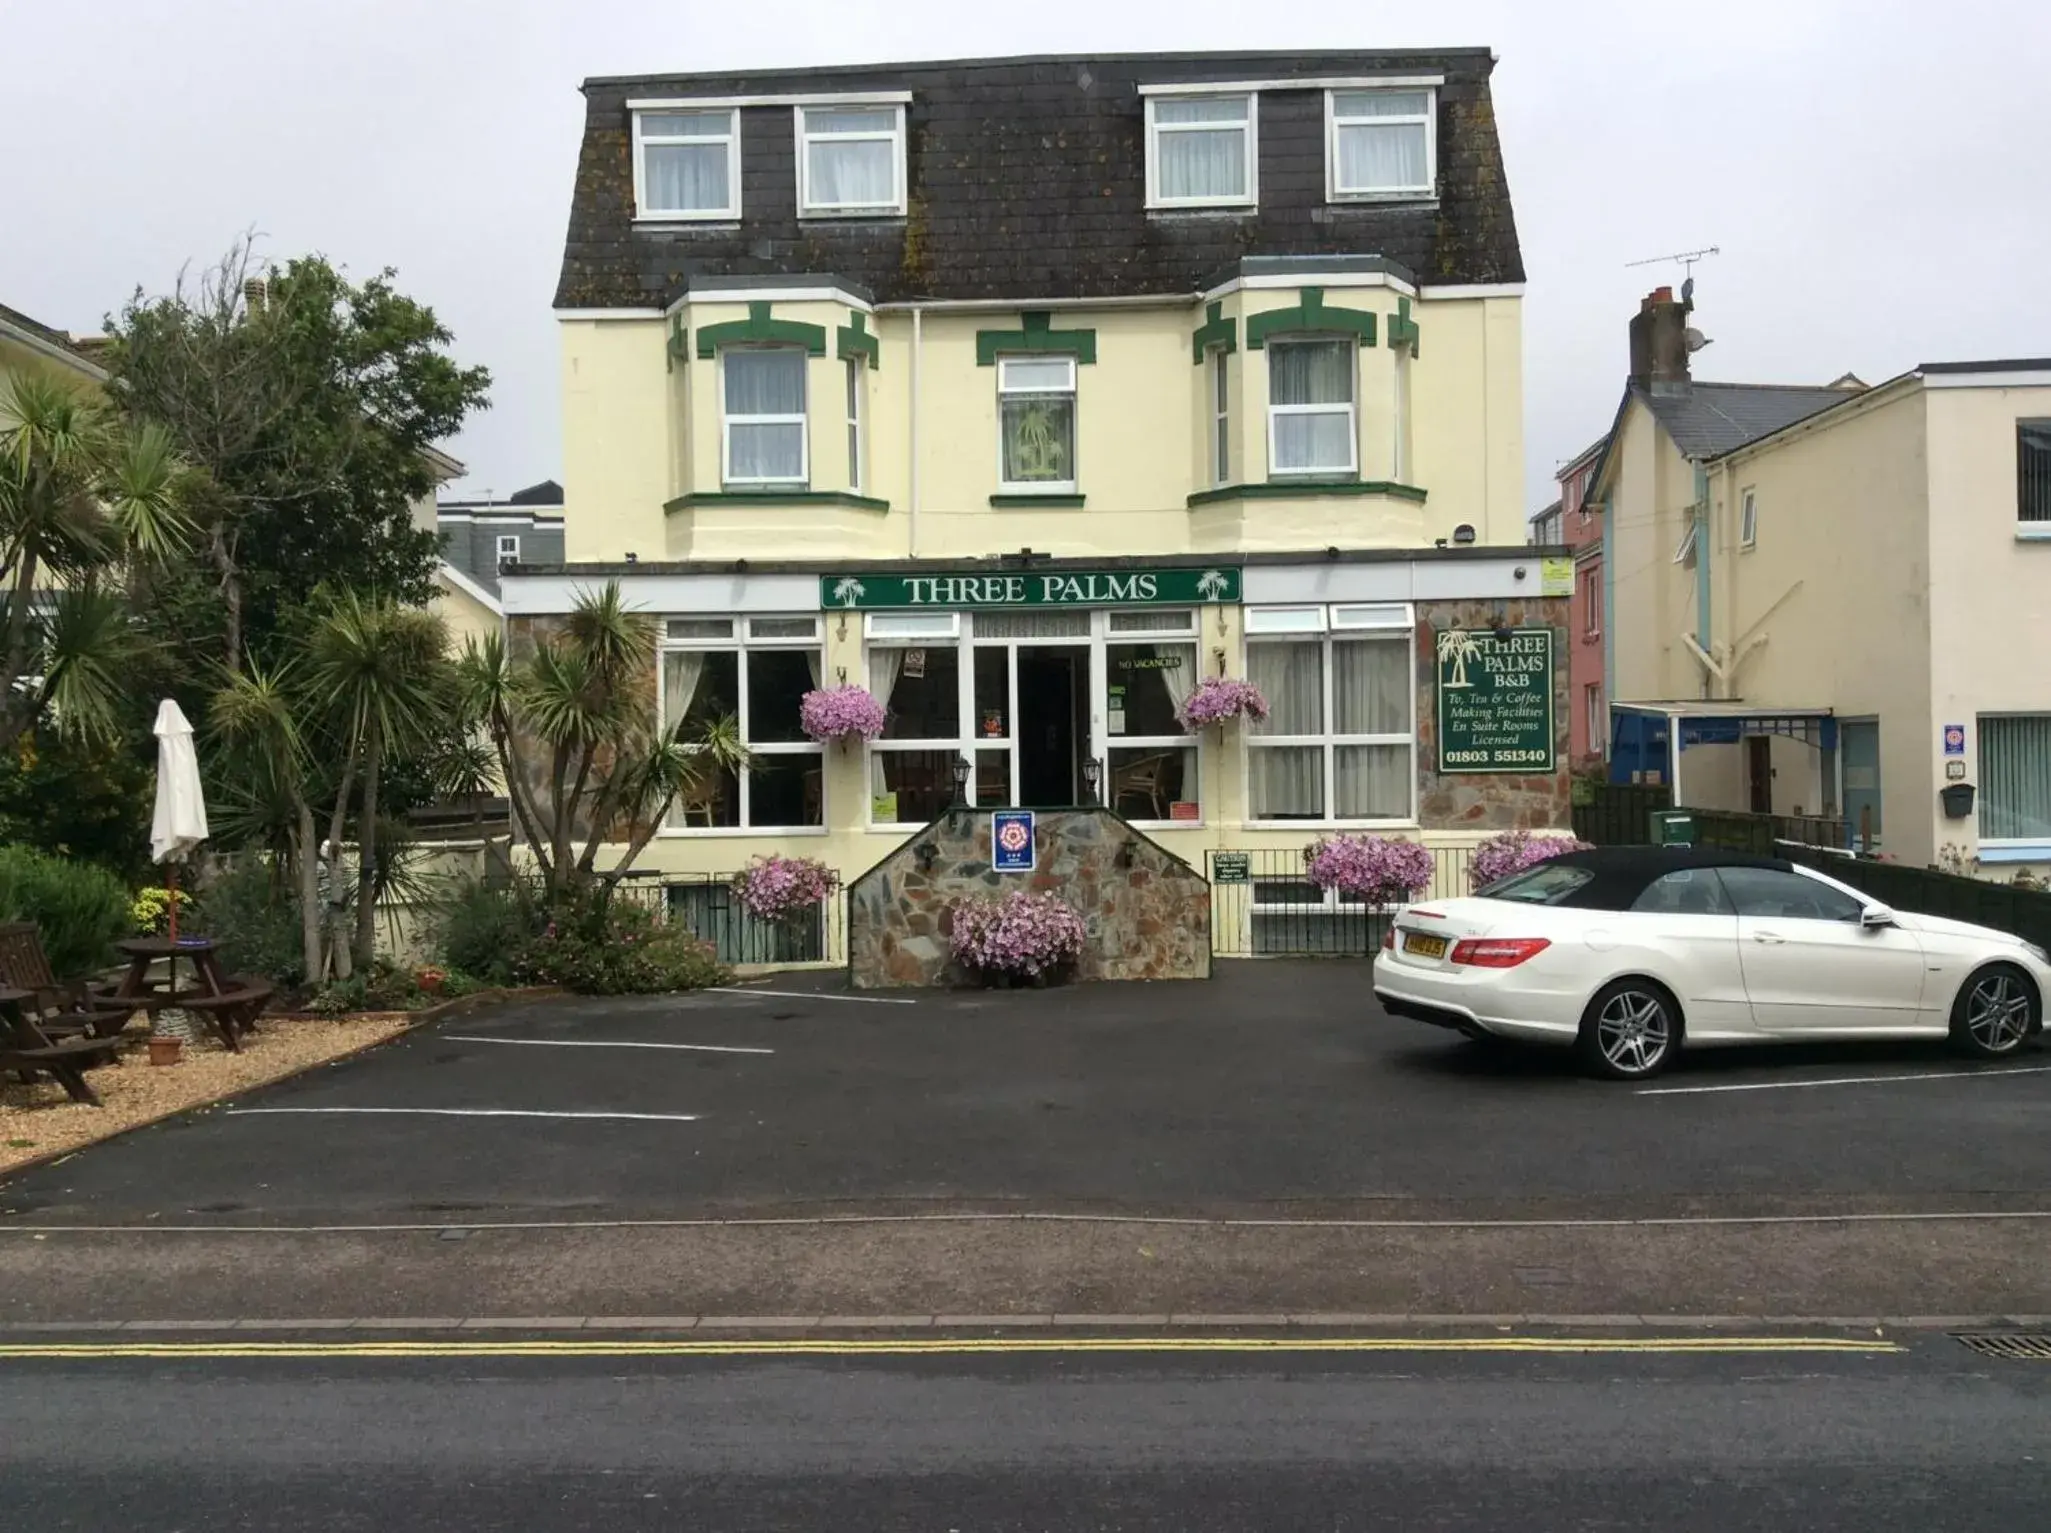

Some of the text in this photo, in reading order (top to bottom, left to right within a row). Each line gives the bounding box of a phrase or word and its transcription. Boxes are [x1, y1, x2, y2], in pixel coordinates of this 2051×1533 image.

[902, 574, 1157, 603] THREE PALMS
[1480, 637, 1546, 654] THREE
[1484, 655, 1544, 672] PALMS
[1494, 674, 1530, 687] B&B
[1469, 692, 1487, 704] Tea
[1491, 693, 1502, 703] &
[1506, 691, 1542, 707] Coffee
[1450, 706, 1544, 720] Making Facilities
[1452, 720, 1539, 732] En Suite Rooms
[1472, 734, 1520, 745] Licensed
[1446, 750, 1546, 762] 01803 551340
